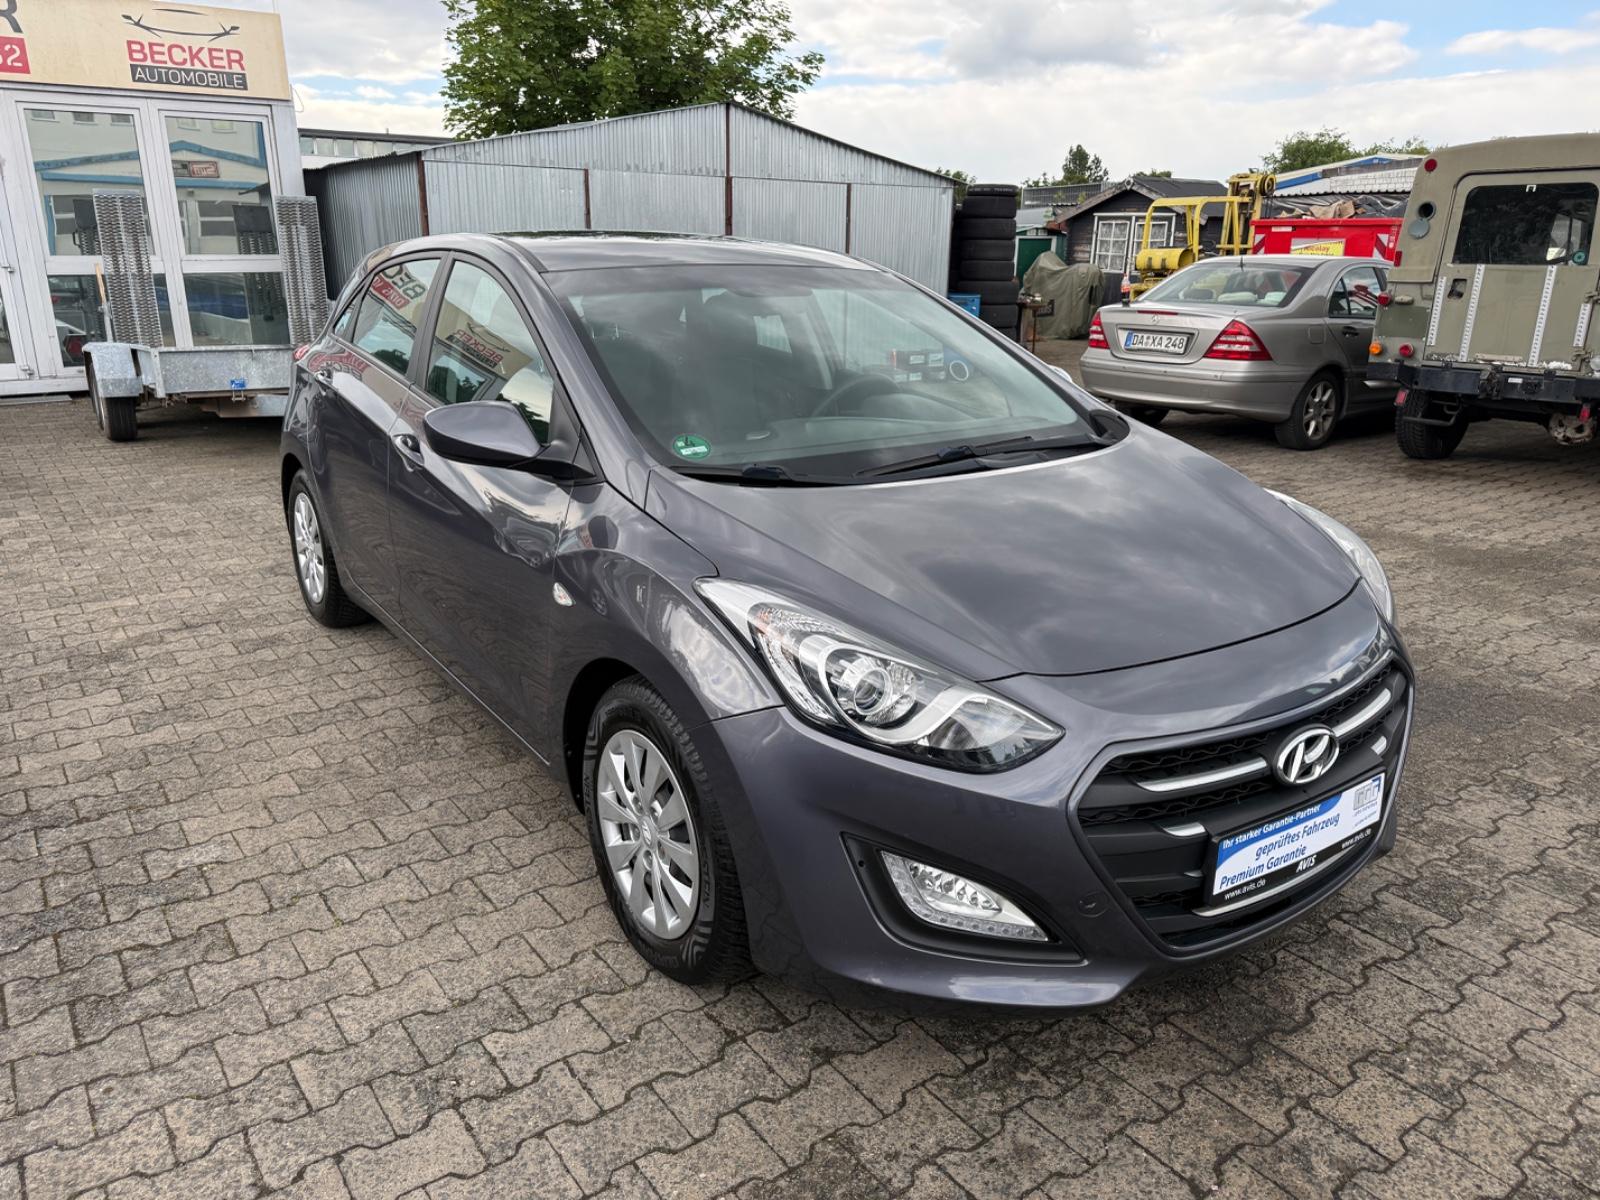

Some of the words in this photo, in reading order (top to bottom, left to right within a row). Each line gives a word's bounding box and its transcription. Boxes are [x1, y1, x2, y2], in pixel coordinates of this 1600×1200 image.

[127, 40, 246, 71] BECKER
[135, 67, 245, 89] AUTOMOBILE
[1131, 334, 1144, 346] DA
[1149, 335, 1163, 348] XA
[1164, 337, 1185, 349] 248
[1222, 838, 1234, 849] Ihr
[1235, 828, 1262, 845] starker
[1262, 804, 1321, 833] Garantie-Partner
[1255, 831, 1301, 860] geprüftes
[1301, 813, 1340, 839] Fahrzeug
[1219, 863, 1265, 889] Premium
[1266, 844, 1307, 869] Garantie
